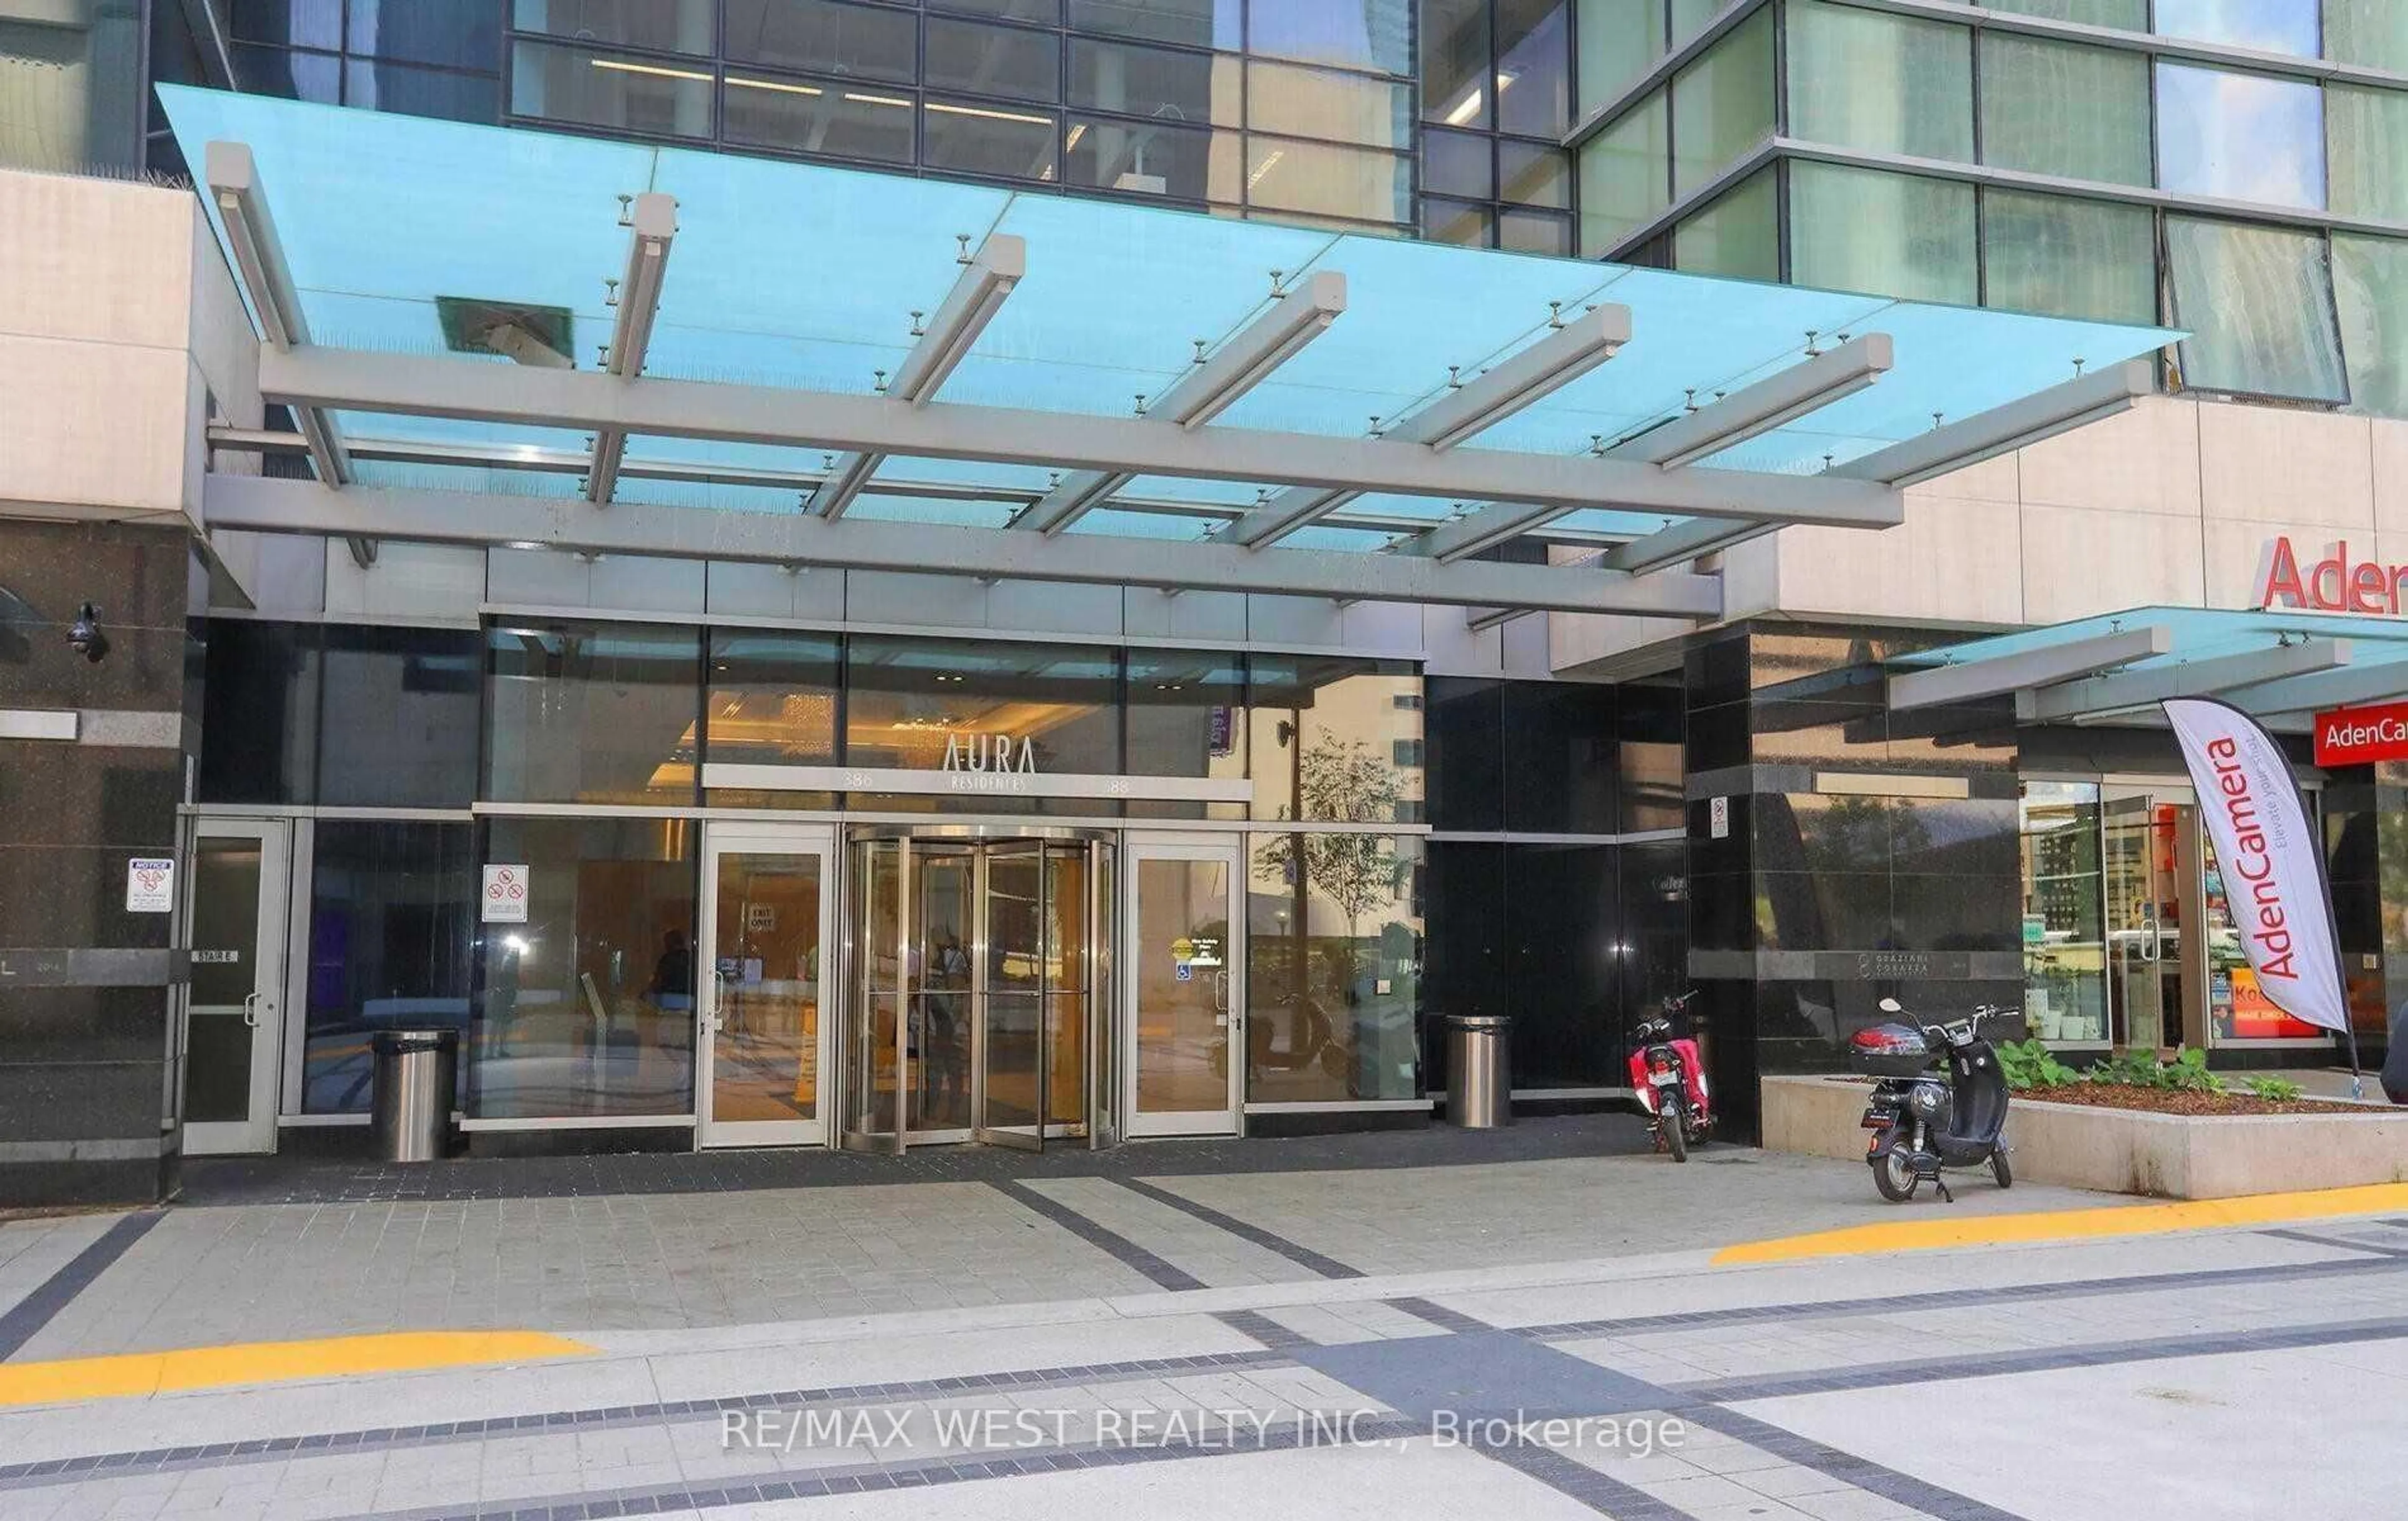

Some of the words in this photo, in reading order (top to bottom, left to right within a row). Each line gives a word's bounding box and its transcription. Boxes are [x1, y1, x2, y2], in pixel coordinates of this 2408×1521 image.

[2325, 718, 2408, 748] AdenCa
[943, 733, 1035, 773] AURA
[951, 776, 1025, 792] RESIDENCES
[2207, 737, 2299, 980] AdenCamera
[2234, 985, 2265, 1002] Ko
